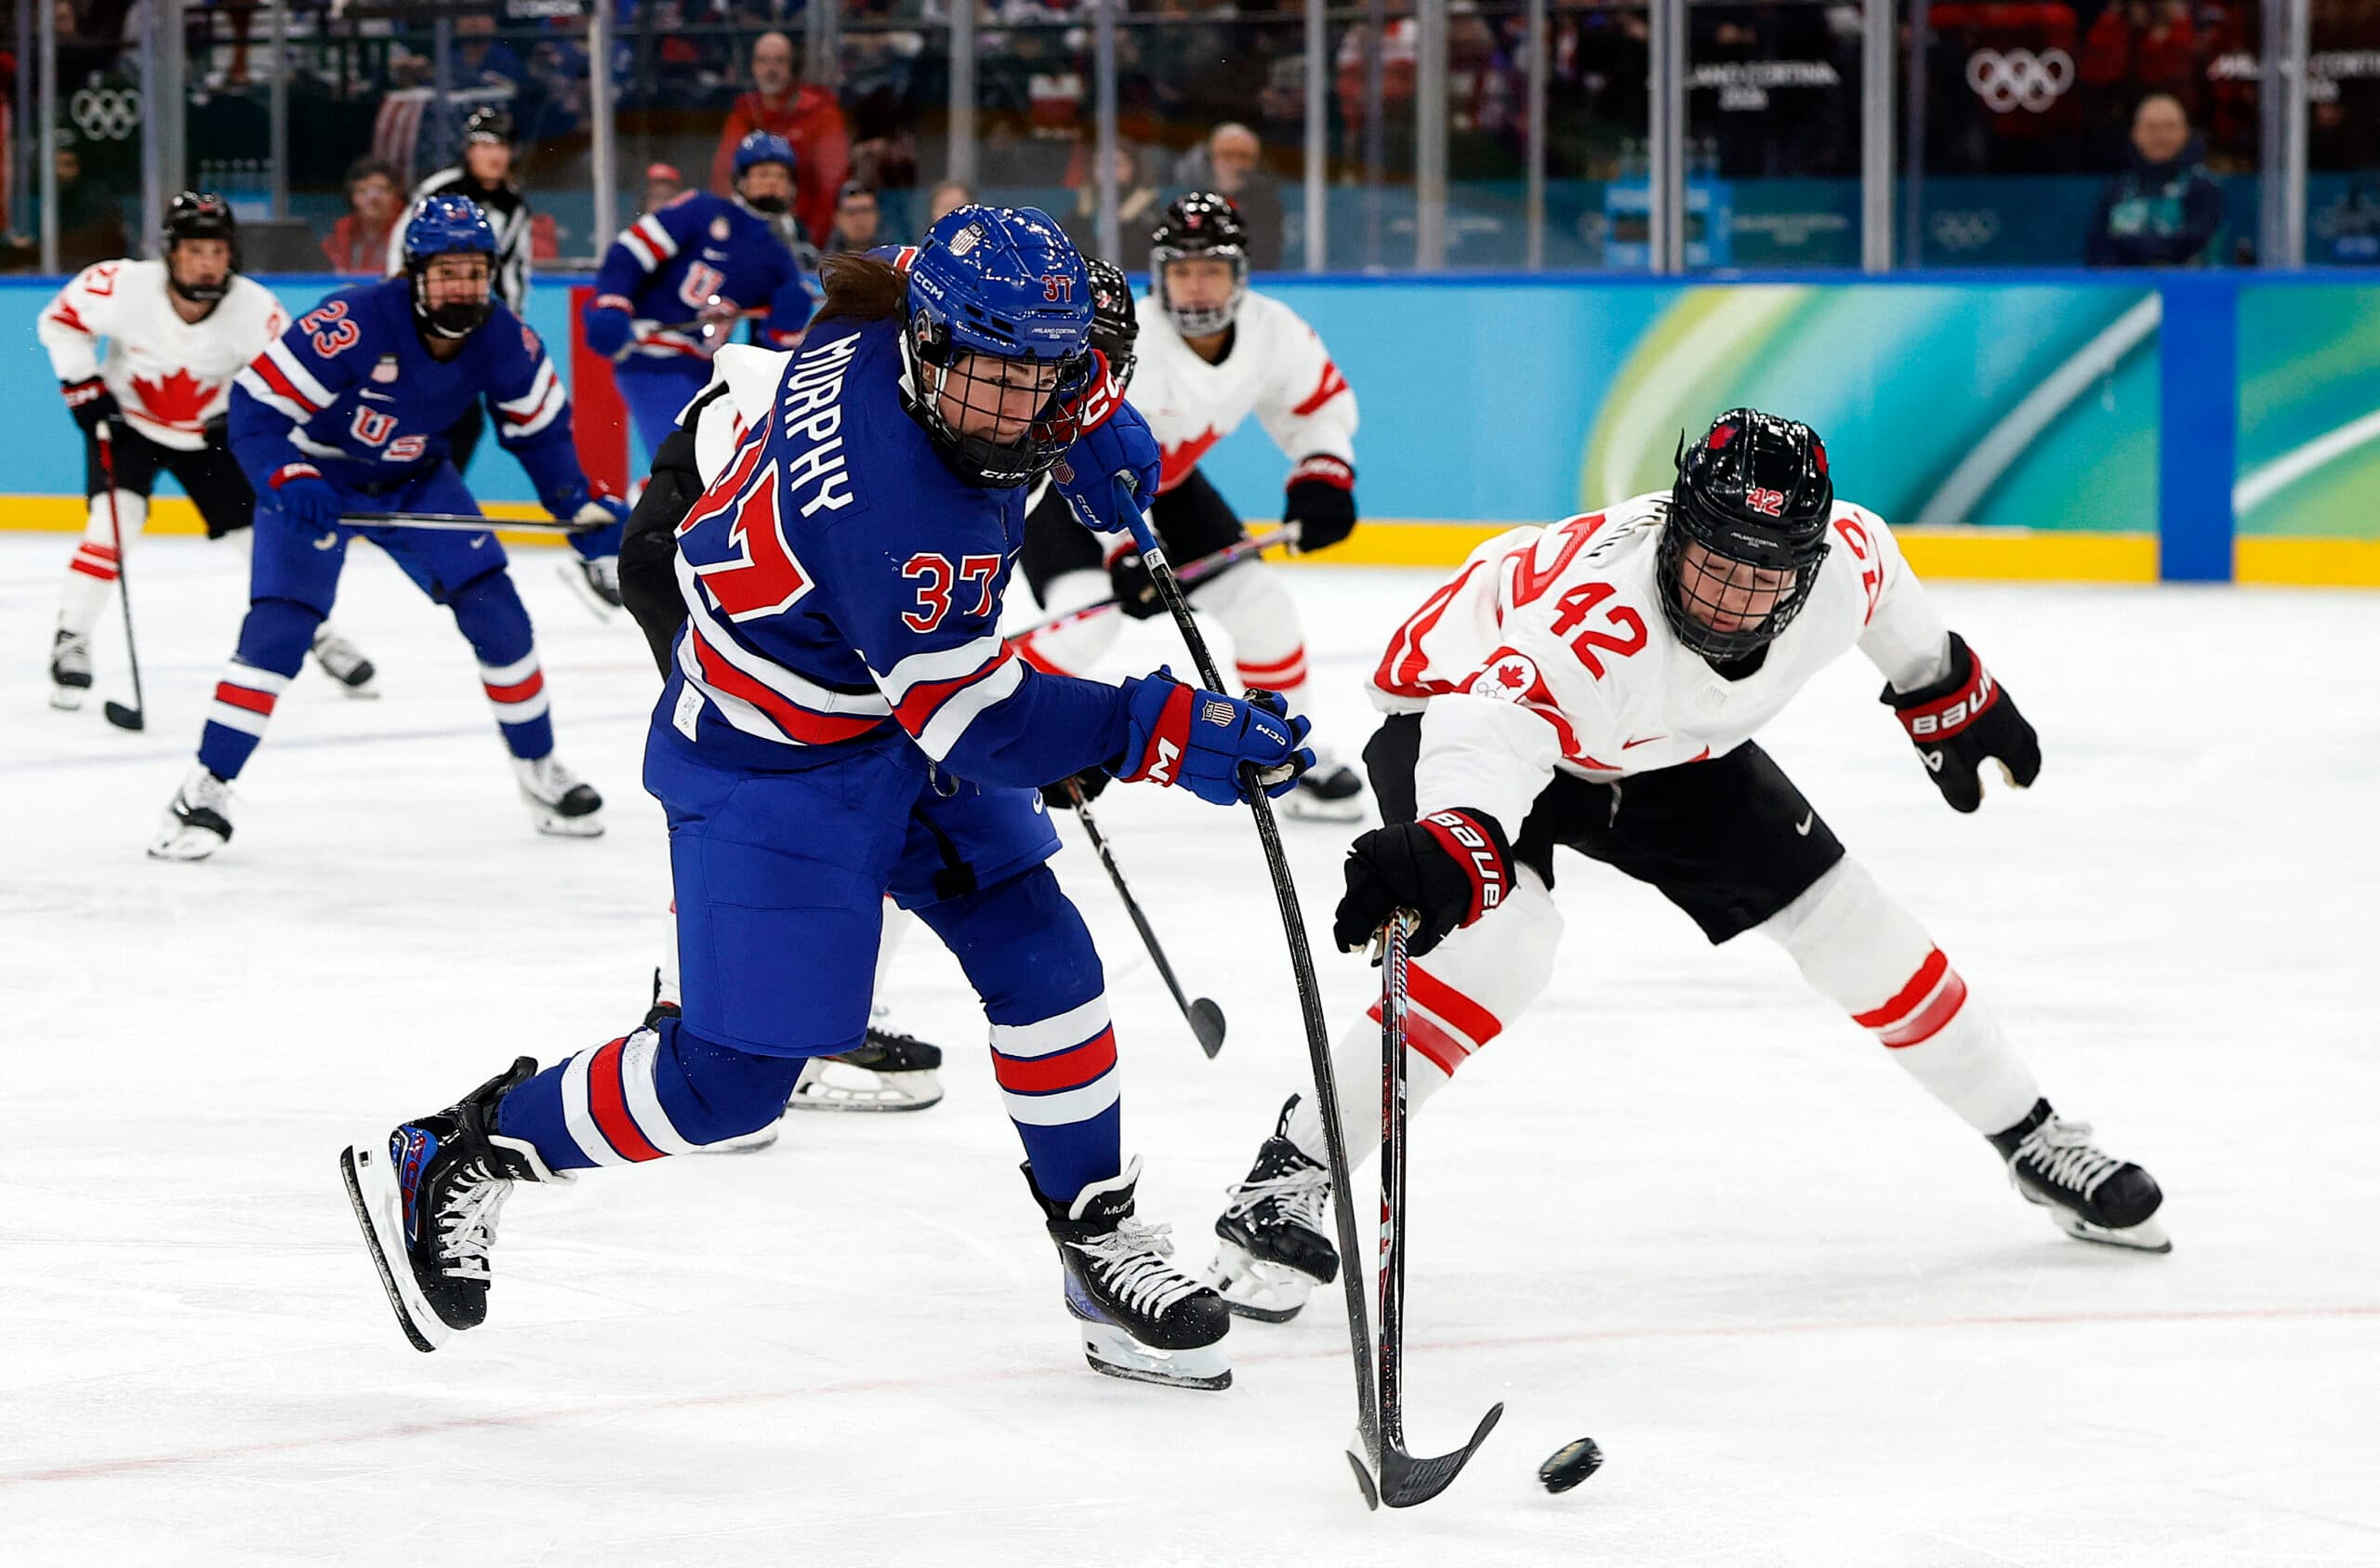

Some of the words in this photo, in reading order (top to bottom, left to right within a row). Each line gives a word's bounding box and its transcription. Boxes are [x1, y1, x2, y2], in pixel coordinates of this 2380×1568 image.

[913, 270, 945, 300] CCM
[1040, 274, 1072, 302] 37
[298, 299, 362, 360] 23
[784, 331, 862, 519] MURPHY
[1076, 494, 1103, 524] CCM
[1746, 487, 1784, 518] 42
[902, 552, 1002, 634] 37
[1550, 582, 1648, 682] 42
[1205, 704, 1214, 718] USA
[1255, 723, 1287, 746] CCM
